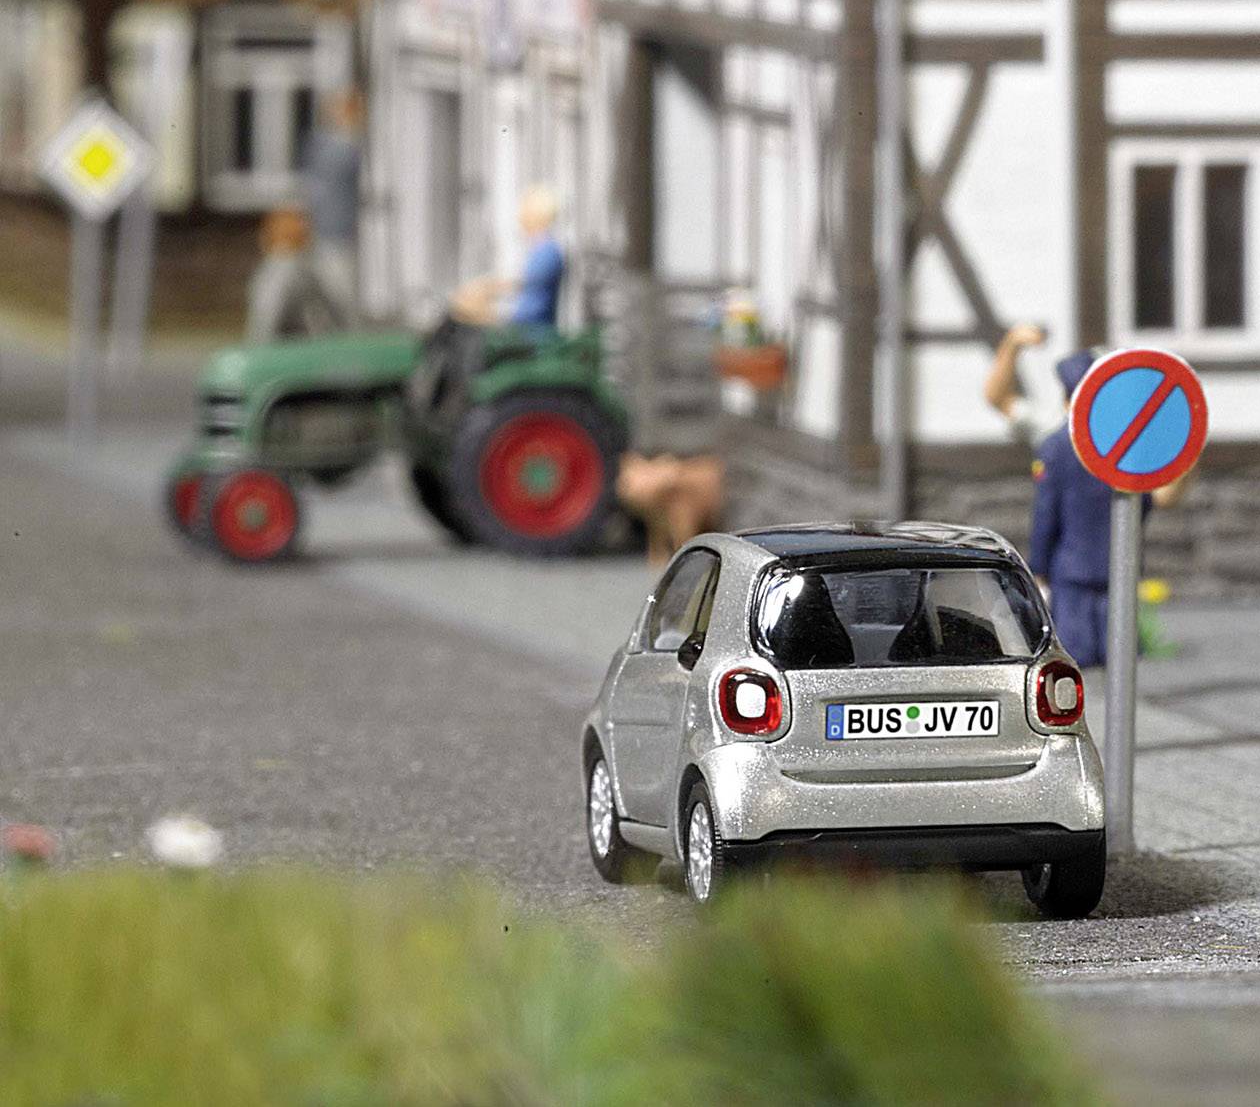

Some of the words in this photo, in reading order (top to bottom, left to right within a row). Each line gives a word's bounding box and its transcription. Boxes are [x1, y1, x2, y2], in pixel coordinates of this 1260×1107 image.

[848, 708, 902, 733] BUS
[925, 707, 957, 732] JV
[965, 706, 993, 731] 70
[831, 725, 840, 736] D
